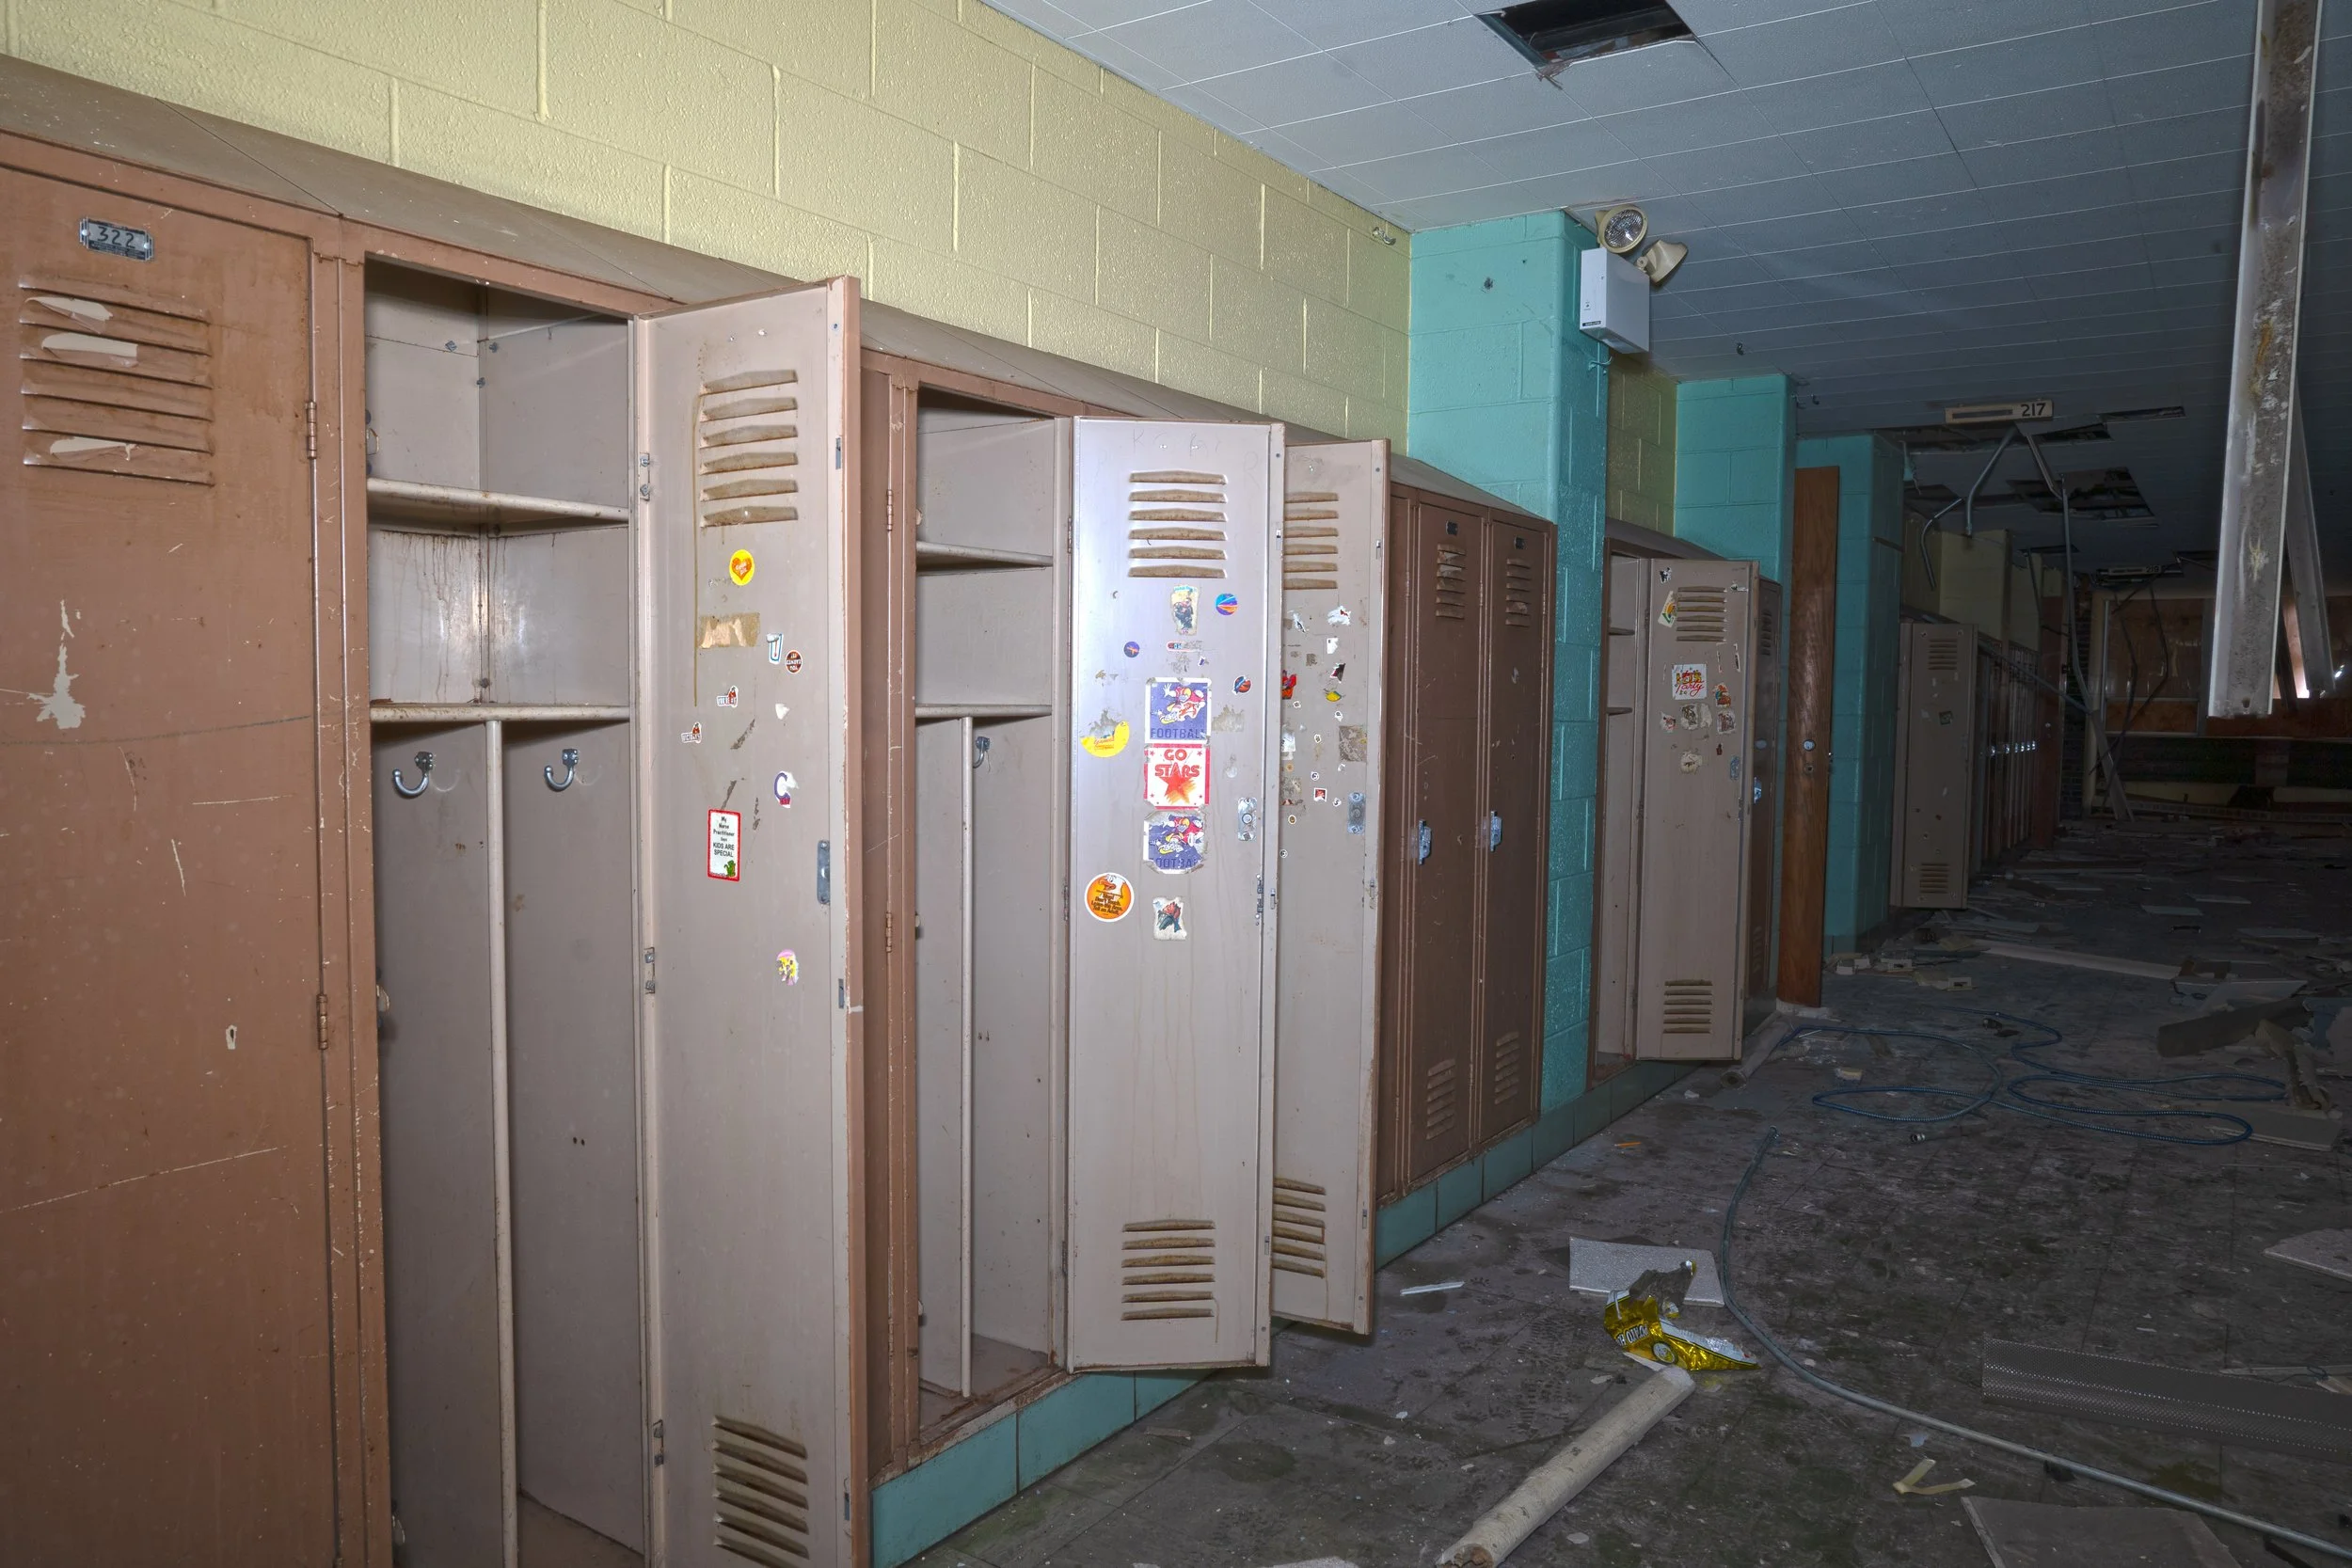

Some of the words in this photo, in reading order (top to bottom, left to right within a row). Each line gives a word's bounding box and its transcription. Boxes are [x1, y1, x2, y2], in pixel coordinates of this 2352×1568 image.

[97, 226, 136, 249] 322
[2020, 402, 2047, 418] 217
[2145, 564, 2161, 574] 219
[1150, 728, 1208, 739] FOOTBALL
[1163, 749, 1187, 762] GO
[1154, 762, 1200, 778] STARS
[713, 828, 735, 837] Practitioner
[714, 848, 734, 858] SPECIAL
